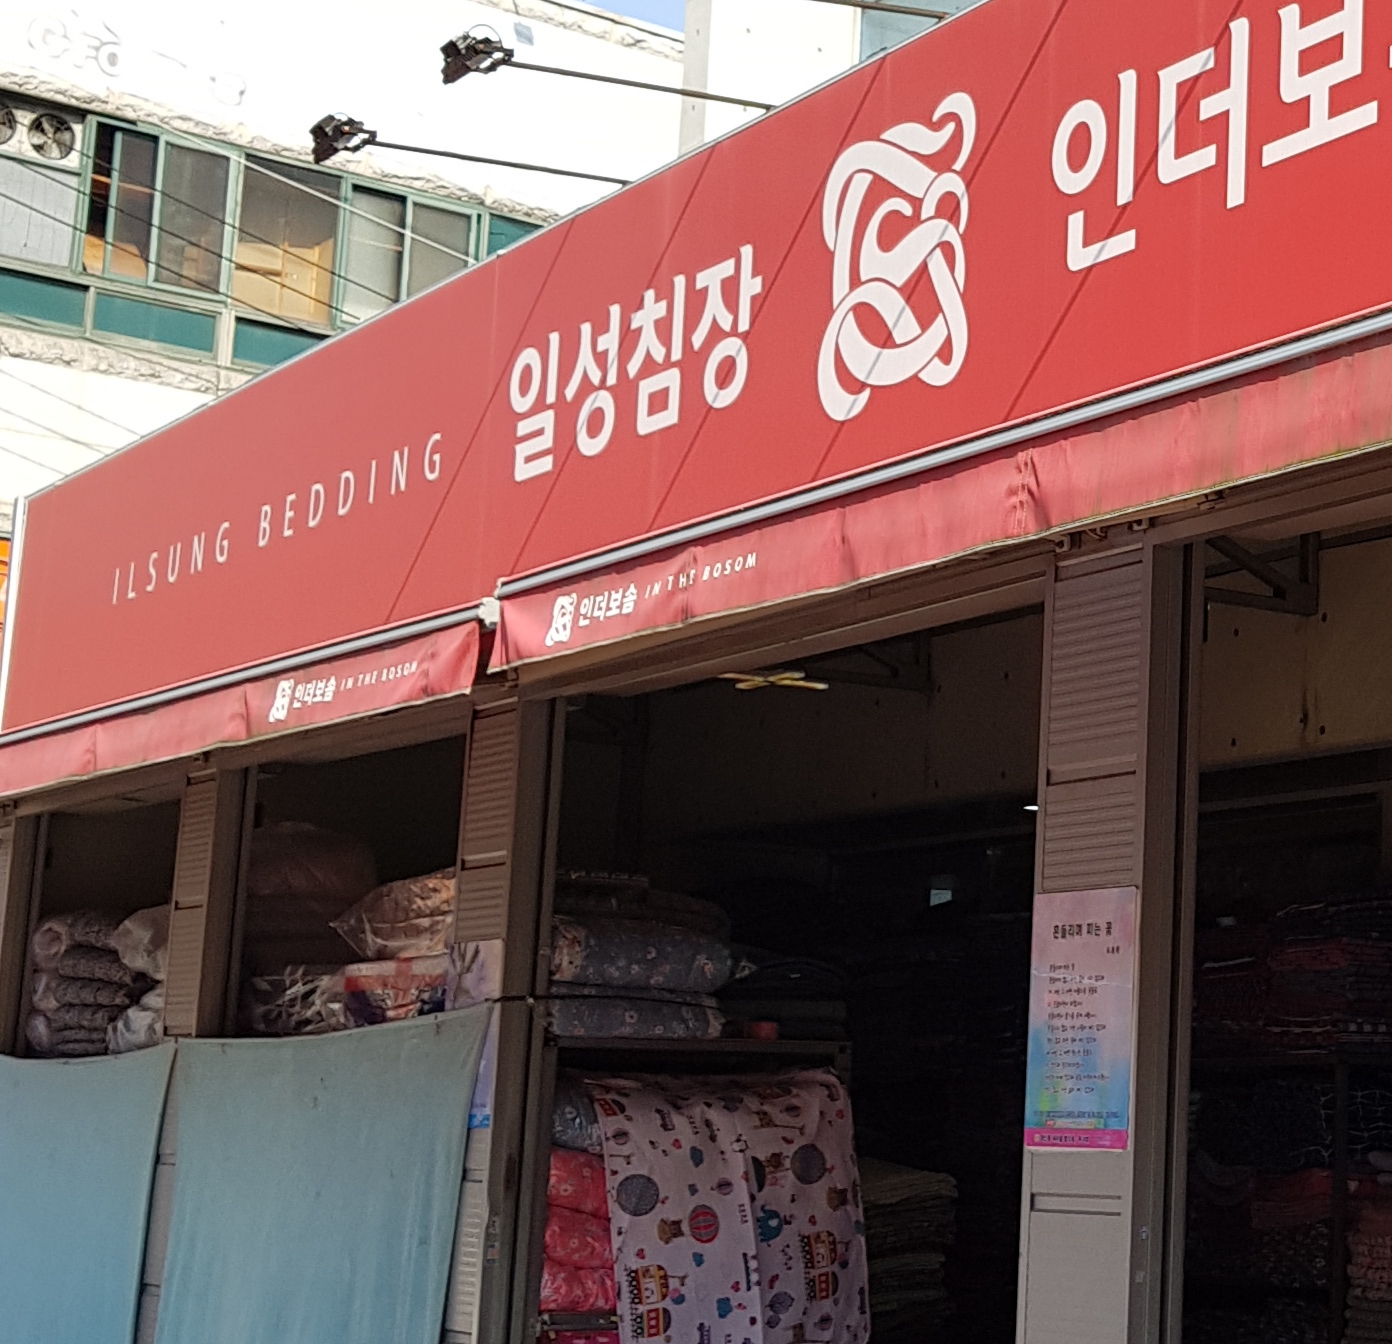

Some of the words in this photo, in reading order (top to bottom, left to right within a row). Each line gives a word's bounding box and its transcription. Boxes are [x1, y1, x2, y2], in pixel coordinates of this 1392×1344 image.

[509, 243, 763, 483] 일성침장
[112, 521, 231, 605] ILSUNG
[257, 433, 443, 548] BEDDING
[644, 580, 662, 599] IN
[667, 569, 697, 591] THE
[701, 552, 757, 583] BOSOM
[578, 583, 639, 627] 인더보솜
[292, 675, 337, 709] 인더보솜
[340, 676, 355, 692] IN
[357, 670, 379, 688] THE
[380, 660, 418, 683] BOSOM
